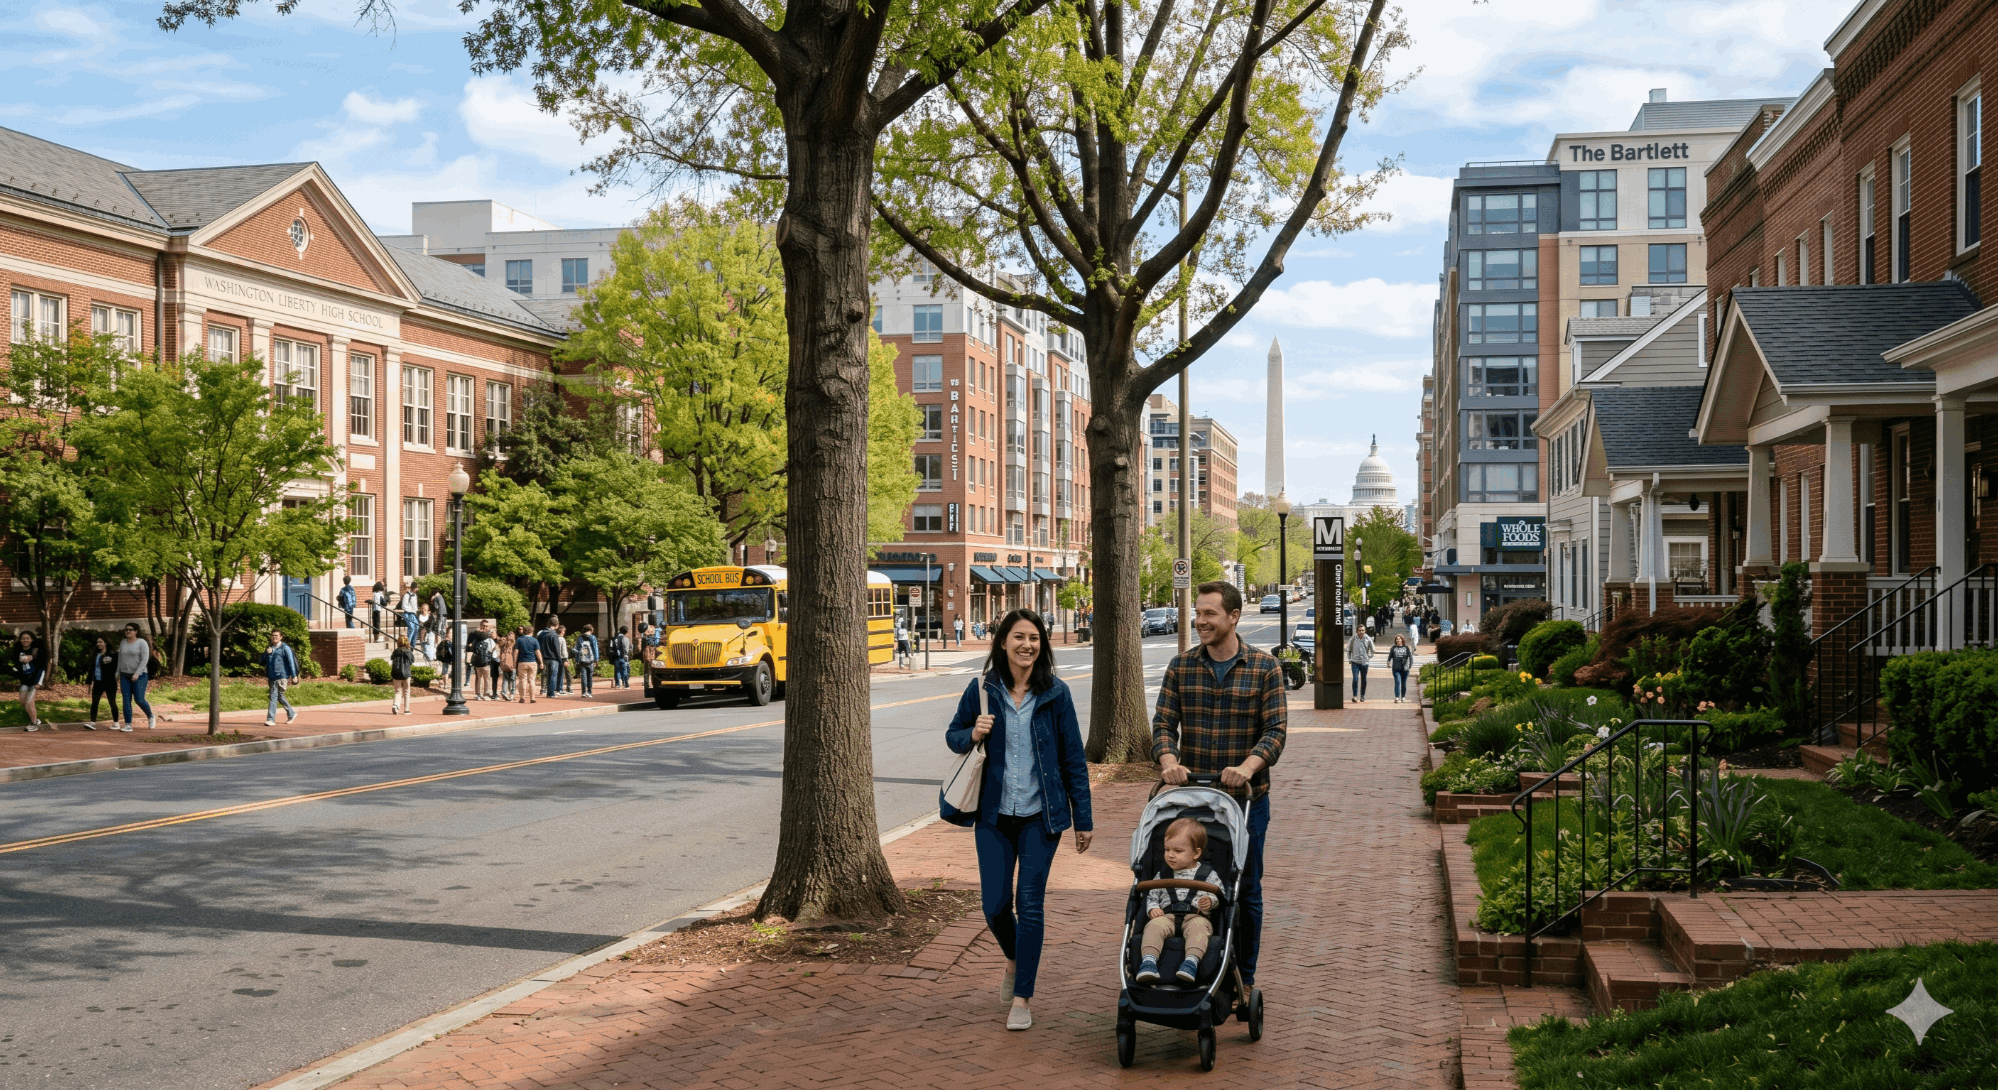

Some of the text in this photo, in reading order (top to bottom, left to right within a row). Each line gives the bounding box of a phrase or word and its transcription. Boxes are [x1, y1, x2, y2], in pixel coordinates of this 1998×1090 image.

[1569, 142, 1689, 162] The Bartlett
[204, 277, 383, 329] WASHINGTON LIBERTY HIGH SCHOOL
[1316, 519, 1342, 545] M
[1501, 521, 1540, 533] WHOLE
[1503, 533, 1540, 542] FOODS
[697, 572, 740, 584] SCHOOL BUS
